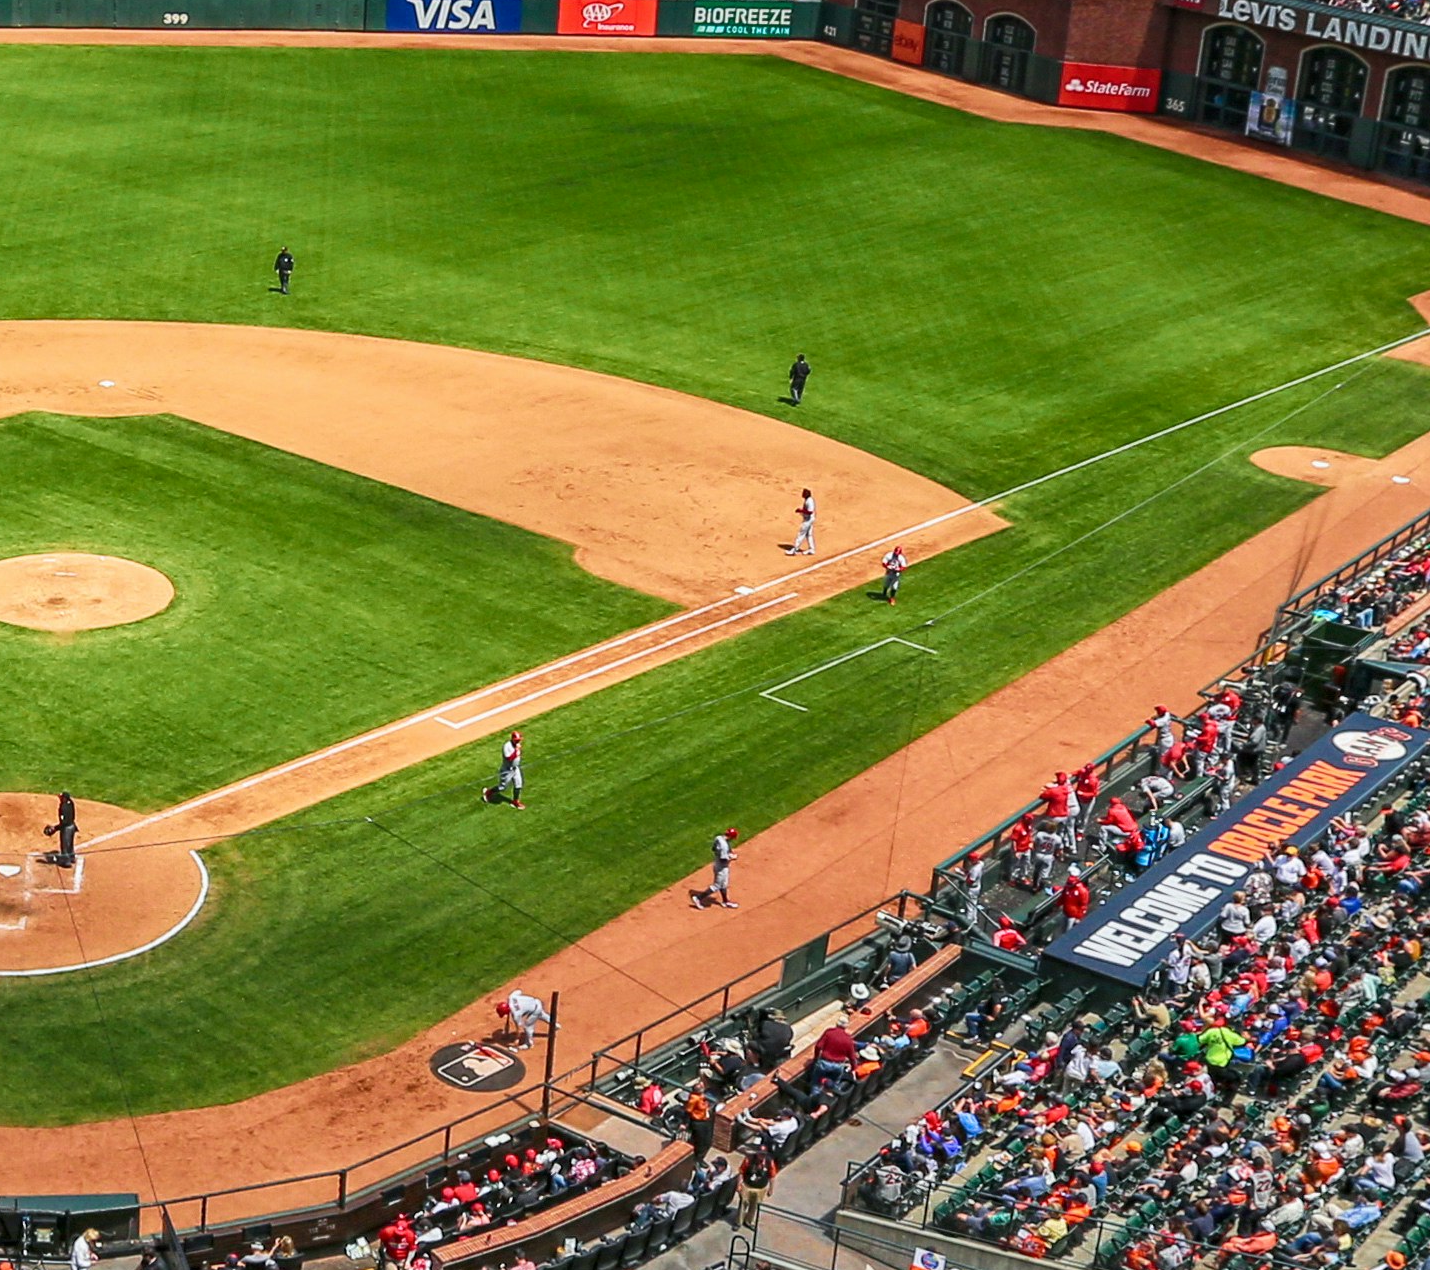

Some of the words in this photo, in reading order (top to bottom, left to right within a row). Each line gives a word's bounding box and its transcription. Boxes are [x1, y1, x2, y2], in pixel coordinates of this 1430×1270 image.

[163, 13, 189, 25] 399
[584, 4, 611, 22] AAA
[694, 7, 792, 25] BIOFREEZE
[597, 23, 635, 31] Insurance
[726, 26, 748, 35] COOL
[751, 26, 767, 35] THE
[770, 27, 791, 35] PAIN
[823, 25, 837, 37] 421
[1166, 98, 1185, 112] 365
[1343, 726, 1413, 768] GIANTS
[1208, 788, 1321, 863] ORACLE
[1277, 760, 1367, 809] PARK
[1073, 875, 1222, 967] WELCOME
[1177, 853, 1249, 886] TO
[1256, 1179, 1271, 1192] 22
